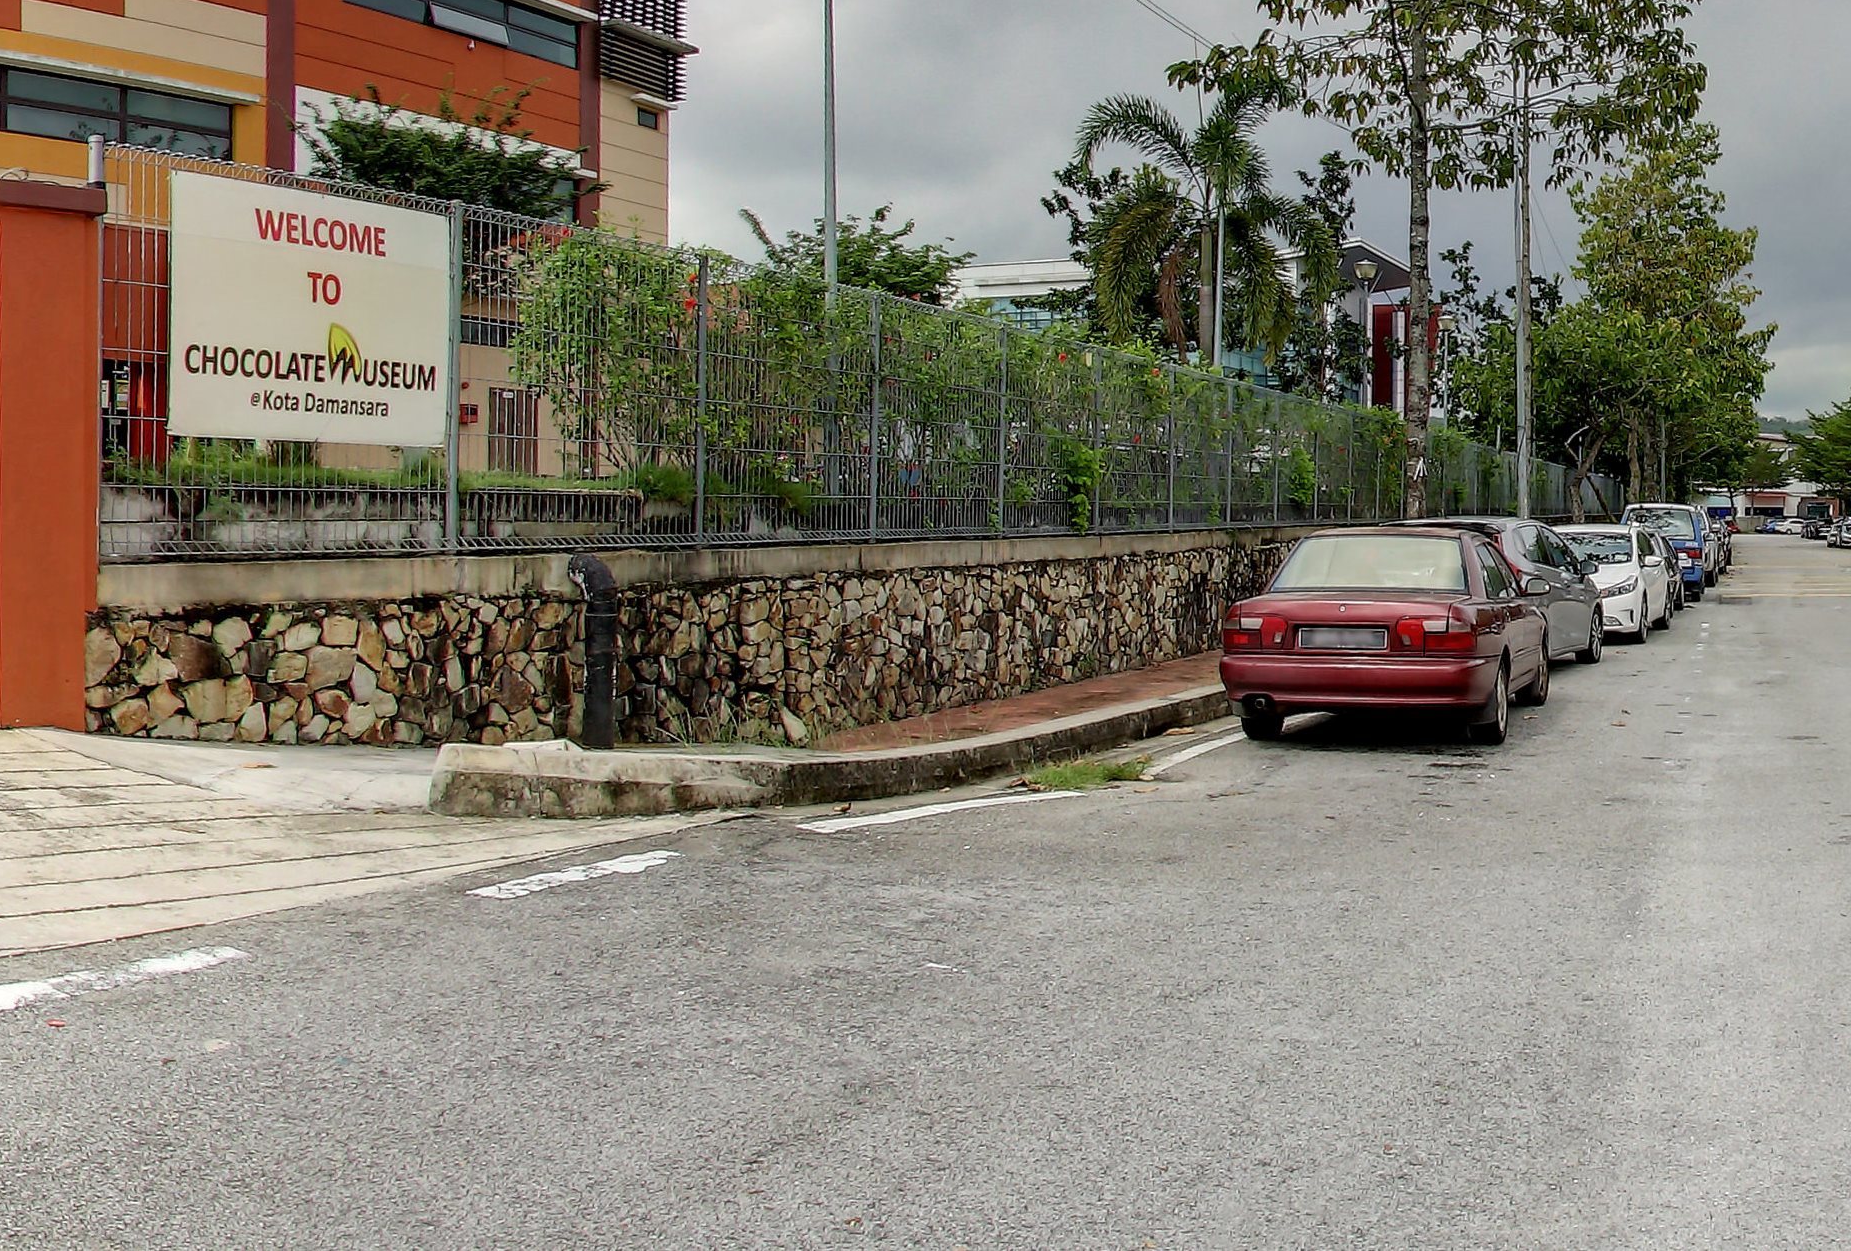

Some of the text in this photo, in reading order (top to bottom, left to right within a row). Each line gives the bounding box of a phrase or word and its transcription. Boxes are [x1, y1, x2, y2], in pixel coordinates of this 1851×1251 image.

[255, 207, 387, 257] WELCOME
[307, 272, 341, 305] TO
[184, 322, 437, 392] CHOCOLATE MUSEUM
[304, 393, 389, 417] Damansara
